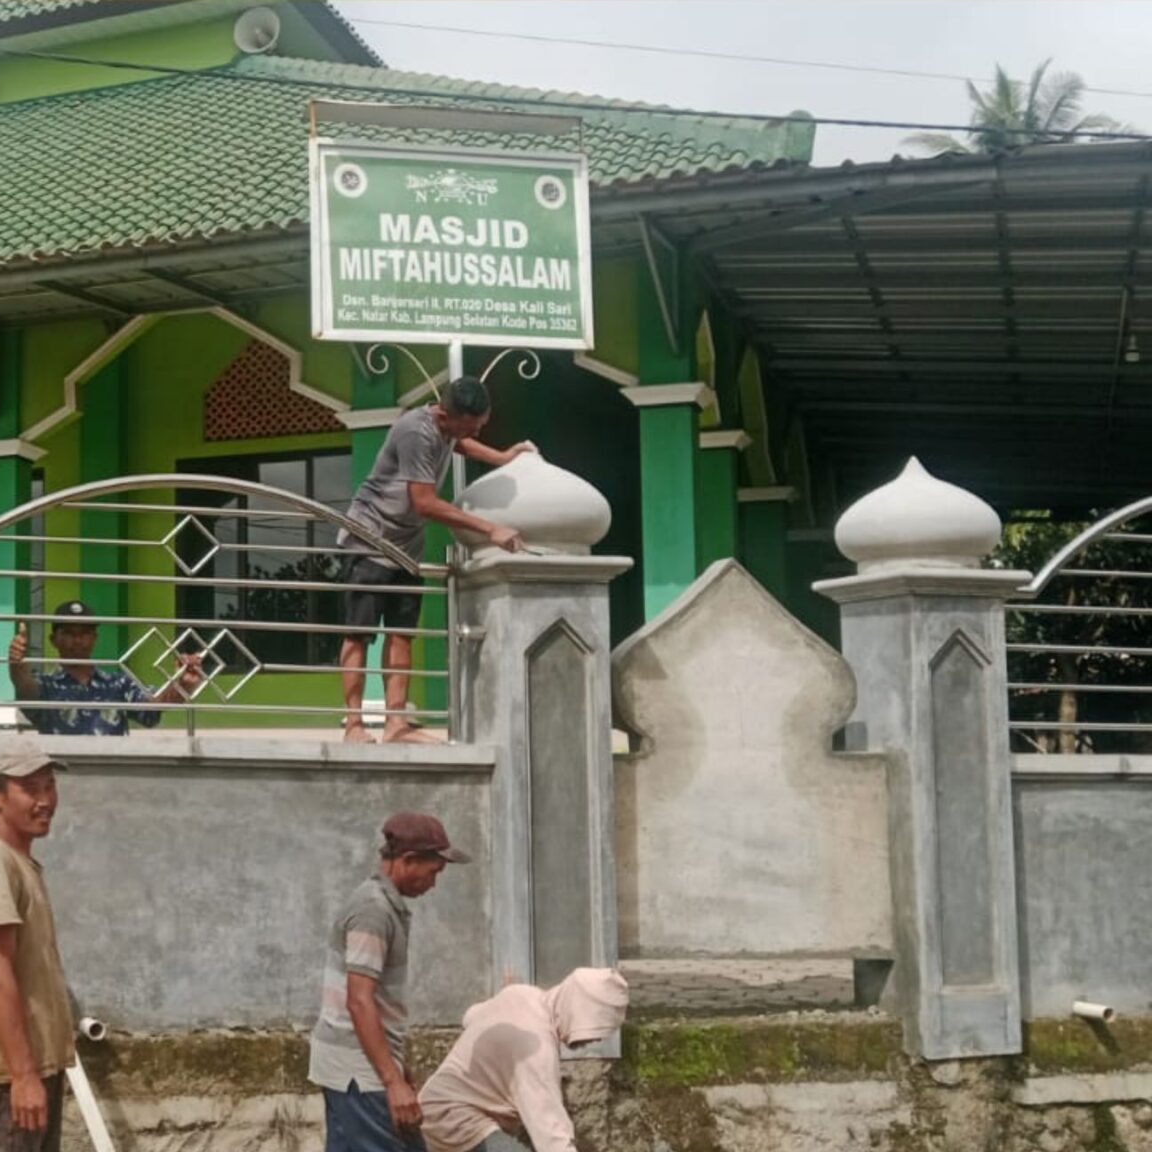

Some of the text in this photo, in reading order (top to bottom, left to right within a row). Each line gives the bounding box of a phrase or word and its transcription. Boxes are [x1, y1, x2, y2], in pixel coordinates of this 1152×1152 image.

[379, 213, 529, 249] MASJID
[339, 248, 572, 291] MIFTAHUSSALAM
[362, 309, 388, 322] Natar
[414, 311, 461, 328] Lampung
[462, 312, 500, 328] Selatan
[502, 314, 528, 329] Kode
[529, 316, 547, 330] Pos
[484, 298, 516, 313] Desa
[519, 300, 544, 314] Kali
[547, 301, 572, 315] Sari
